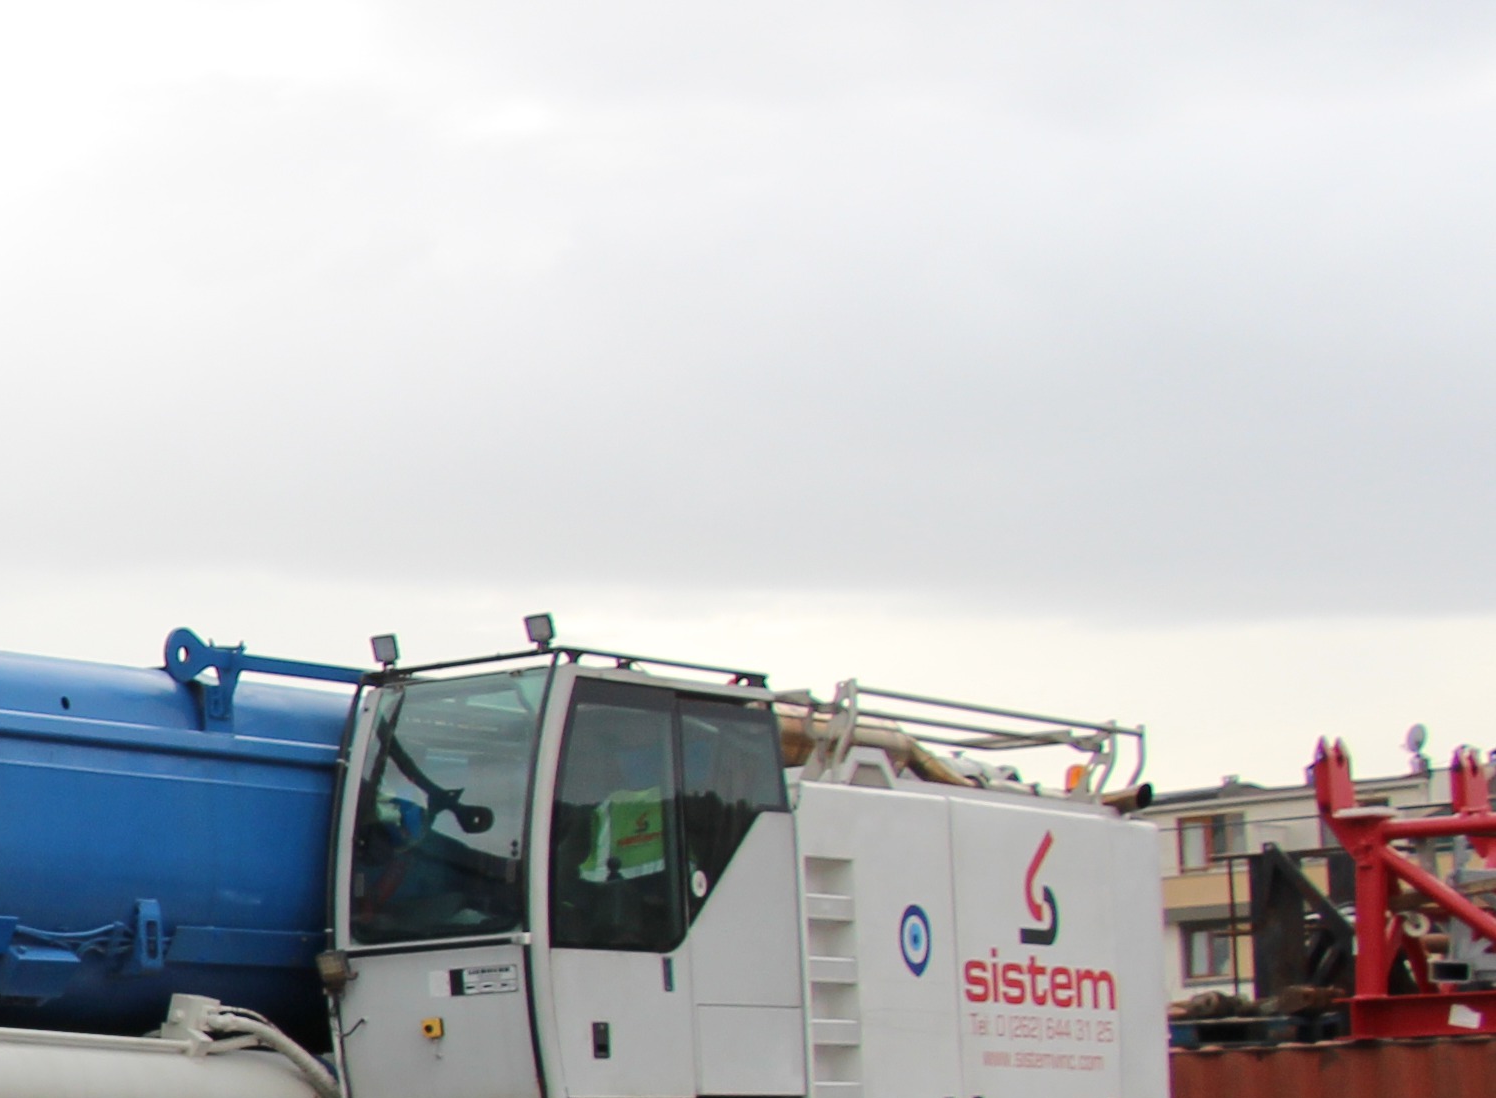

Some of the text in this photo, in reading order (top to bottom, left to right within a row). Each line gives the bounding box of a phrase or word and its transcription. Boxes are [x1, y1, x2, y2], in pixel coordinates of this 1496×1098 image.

[964, 947, 1116, 1010] sistem
[1046, 1017, 1072, 1040] 644
[1096, 1020, 1114, 1043] 25
